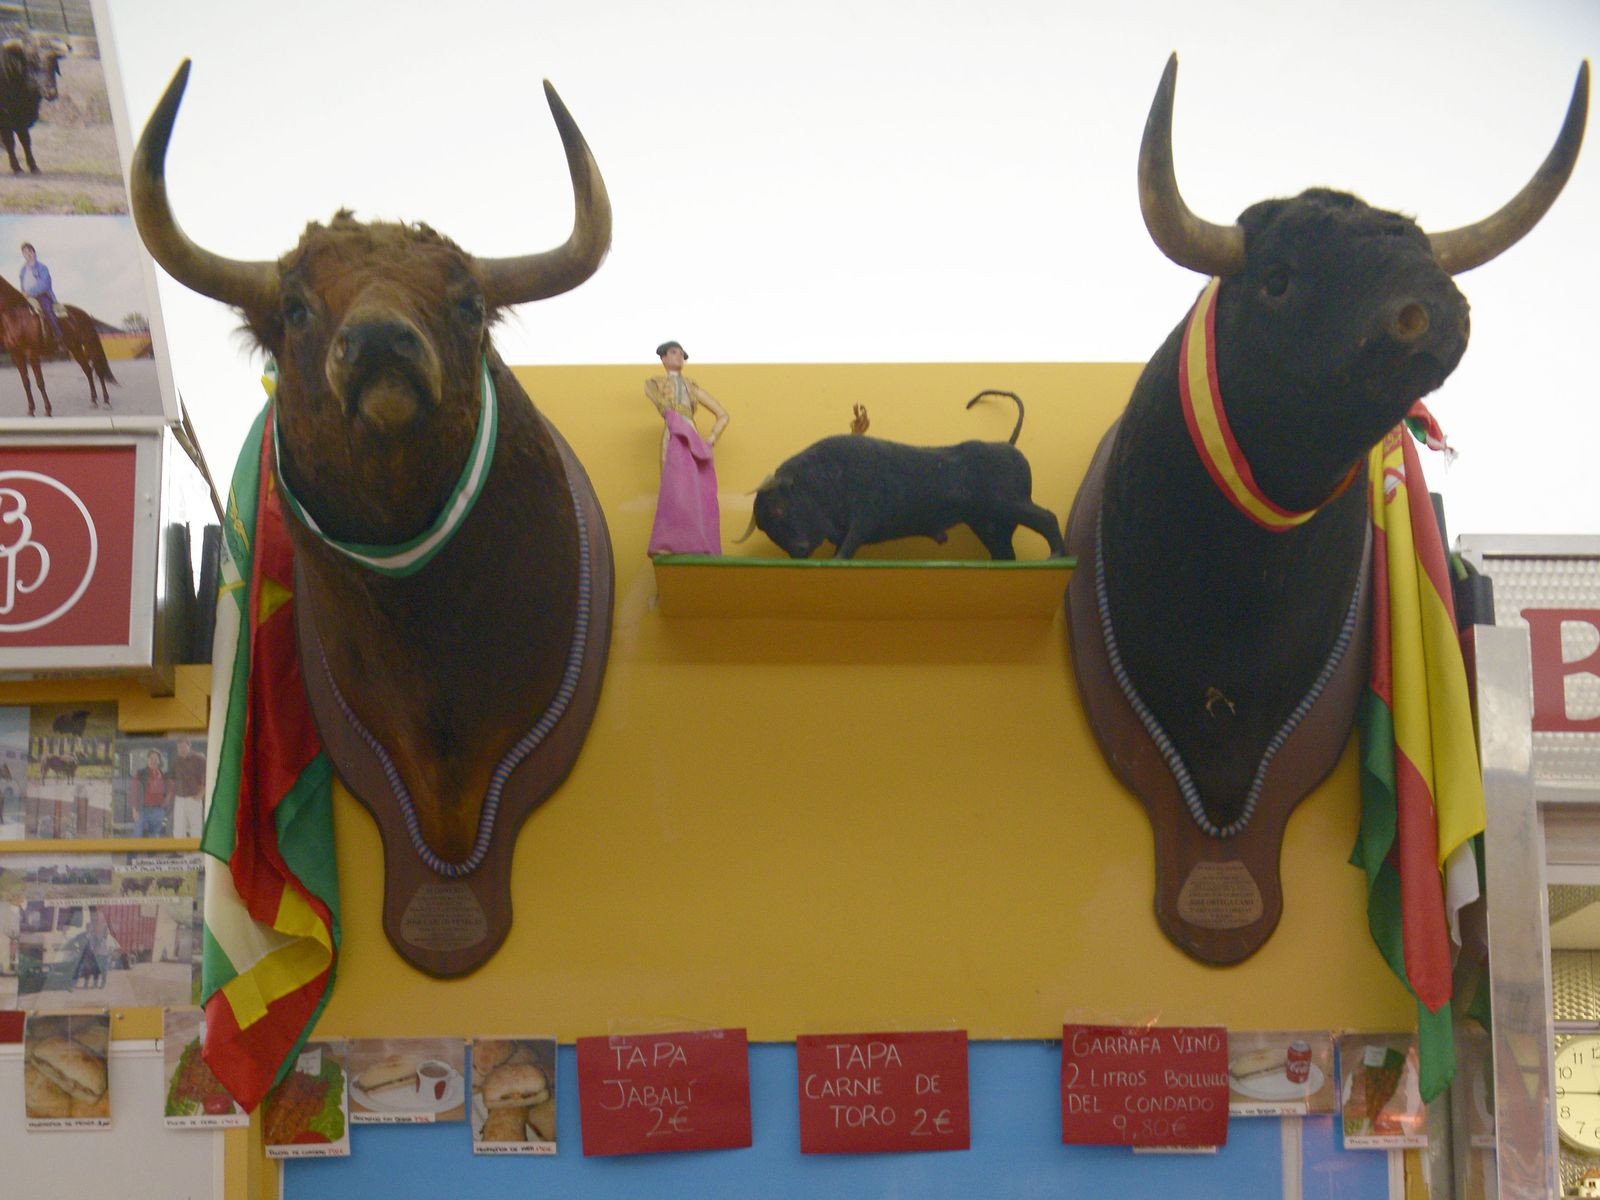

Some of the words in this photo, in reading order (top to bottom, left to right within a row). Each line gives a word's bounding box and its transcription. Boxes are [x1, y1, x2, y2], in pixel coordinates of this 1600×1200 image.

[611, 1042, 688, 1071] TAPA
[826, 1043, 902, 1071] TAPA
[1072, 1032, 1161, 1058] GARRAFA
[1173, 1033, 1220, 1053] VINO
[1573, 1053, 1583, 1065] 11
[1065, 1062, 1086, 1089] 2
[1090, 1068, 1147, 1088] LITROS
[1559, 1066, 1573, 1080] 10
[805, 1073, 883, 1100] CARNE
[915, 1073, 941, 1094] DE
[830, 1103, 896, 1129] TORO
[1068, 1093, 1102, 1114] DEL
[1124, 1095, 1214, 1114] CONDADO
[1560, 1105, 1571, 1120] 8
[1576, 1121, 1586, 1135] 7
